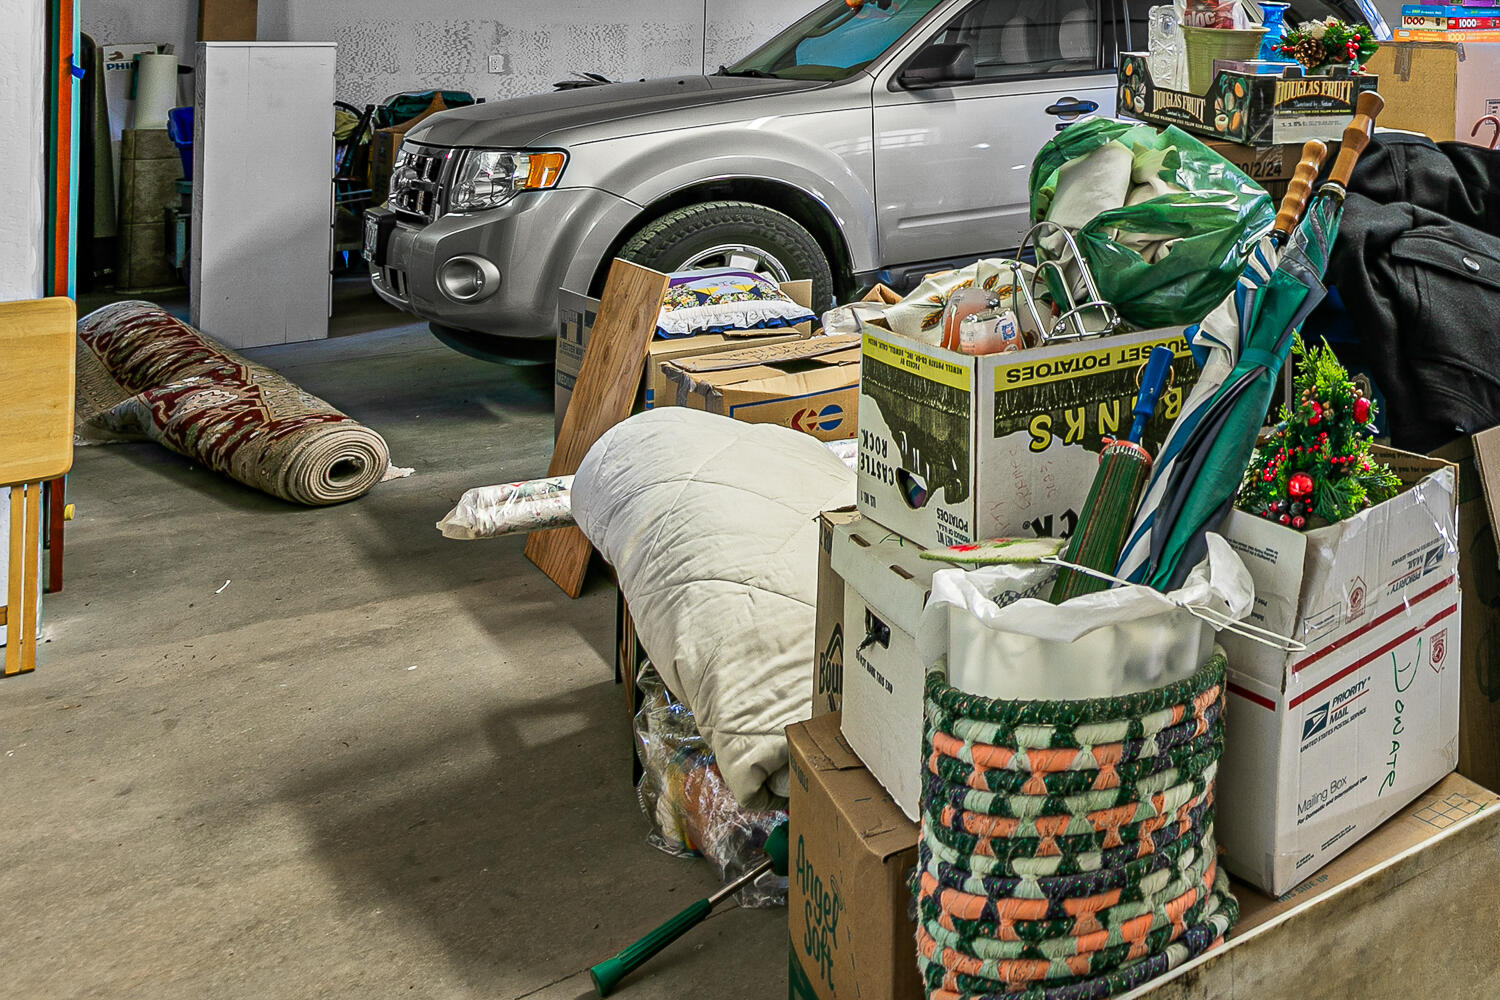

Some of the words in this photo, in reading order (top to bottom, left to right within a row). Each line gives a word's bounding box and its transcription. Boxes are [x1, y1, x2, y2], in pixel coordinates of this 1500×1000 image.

[1403, 17, 1425, 25] 1000
[1459, 18, 1477, 27] 1000
[1152, 89, 1182, 113] DOUGLAS
[1182, 95, 1206, 123] FRUIT
[1274, 80, 1320, 107] DOUGLAS
[1320, 80, 1354, 104] FRUIT
[928, 360, 944, 370] POTATO
[1005, 353, 1111, 384] POTATOES
[1028, 387, 1183, 453] BNKS
[861, 429, 887, 459] ROCK
[860, 452, 894, 486] CASTLE
[936, 508, 969, 532] POTATOES
[1407, 554, 1424, 570] MAIL
[1391, 572, 1422, 593] PRIORITY
[1332, 678, 1367, 707] PRIORITY
[1300, 738, 1316, 752] UNITED
[1316, 729, 1334, 744] STATES
[1334, 718, 1350, 732] POSTAL
[1350, 707, 1368, 723] SERVICE
[1329, 707, 1350, 725] MAIL
[1296, 790, 1328, 816] Mailing
[1330, 776, 1348, 794] Box
[1296, 816, 1305, 826] For
[1305, 805, 1326, 822] Domestic
[1326, 801, 1334, 810] and
[1334, 782, 1359, 803] International
[1358, 775, 1368, 784] Use
[796, 834, 839, 950] Angel
[804, 900, 835, 992] Soft
